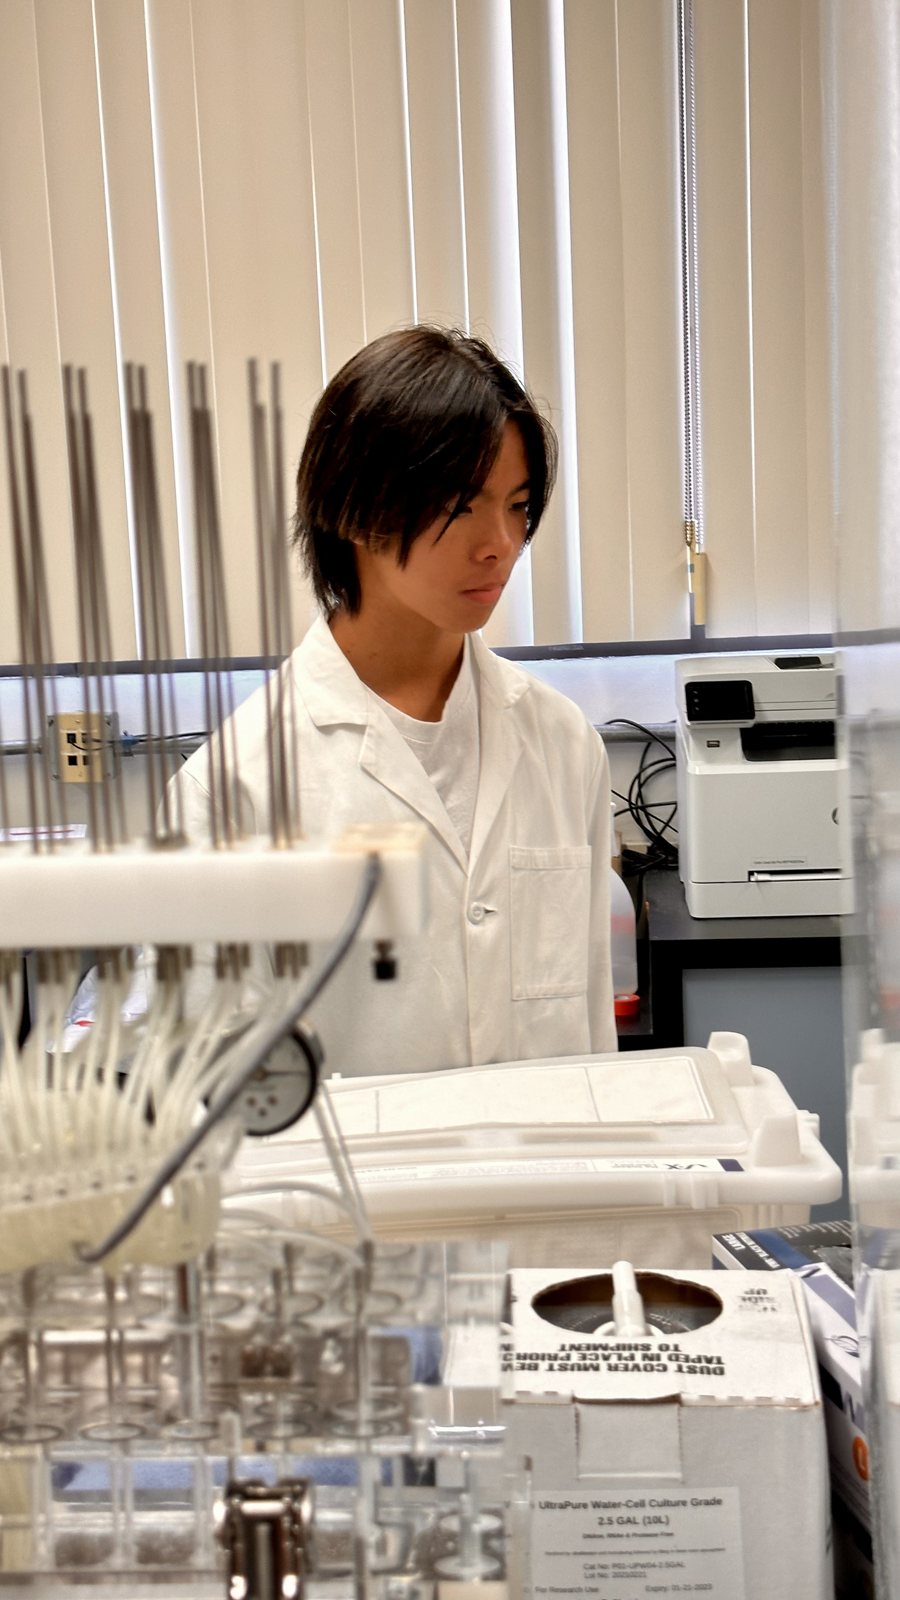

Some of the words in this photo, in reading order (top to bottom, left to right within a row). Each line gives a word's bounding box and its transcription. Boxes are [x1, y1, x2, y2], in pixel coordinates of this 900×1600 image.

[558, 1343, 652, 1352] SHIPMENT
[657, 1343, 682, 1352] TO
[515, 1352, 571, 1361] PRIOR
[577, 1352, 635, 1361] PLACE
[642, 1352, 661, 1361] IN
[667, 1353, 725, 1365] TAPED
[515, 1362, 539, 1371] BE
[545, 1362, 601, 1371] MUST
[607, 1363, 668, 1372] COVER
[674, 1364, 725, 1376] DUST
[538, 1500, 588, 1509] UltraPure
[590, 1499, 646, 1509] Water-Cell
[649, 1498, 688, 1507] Culture
[690, 1496, 723, 1506] Grade
[597, 1516, 613, 1525] 2.5
[616, 1515, 640, 1525] GAL
[642, 1514, 670, 1526] (10L)
